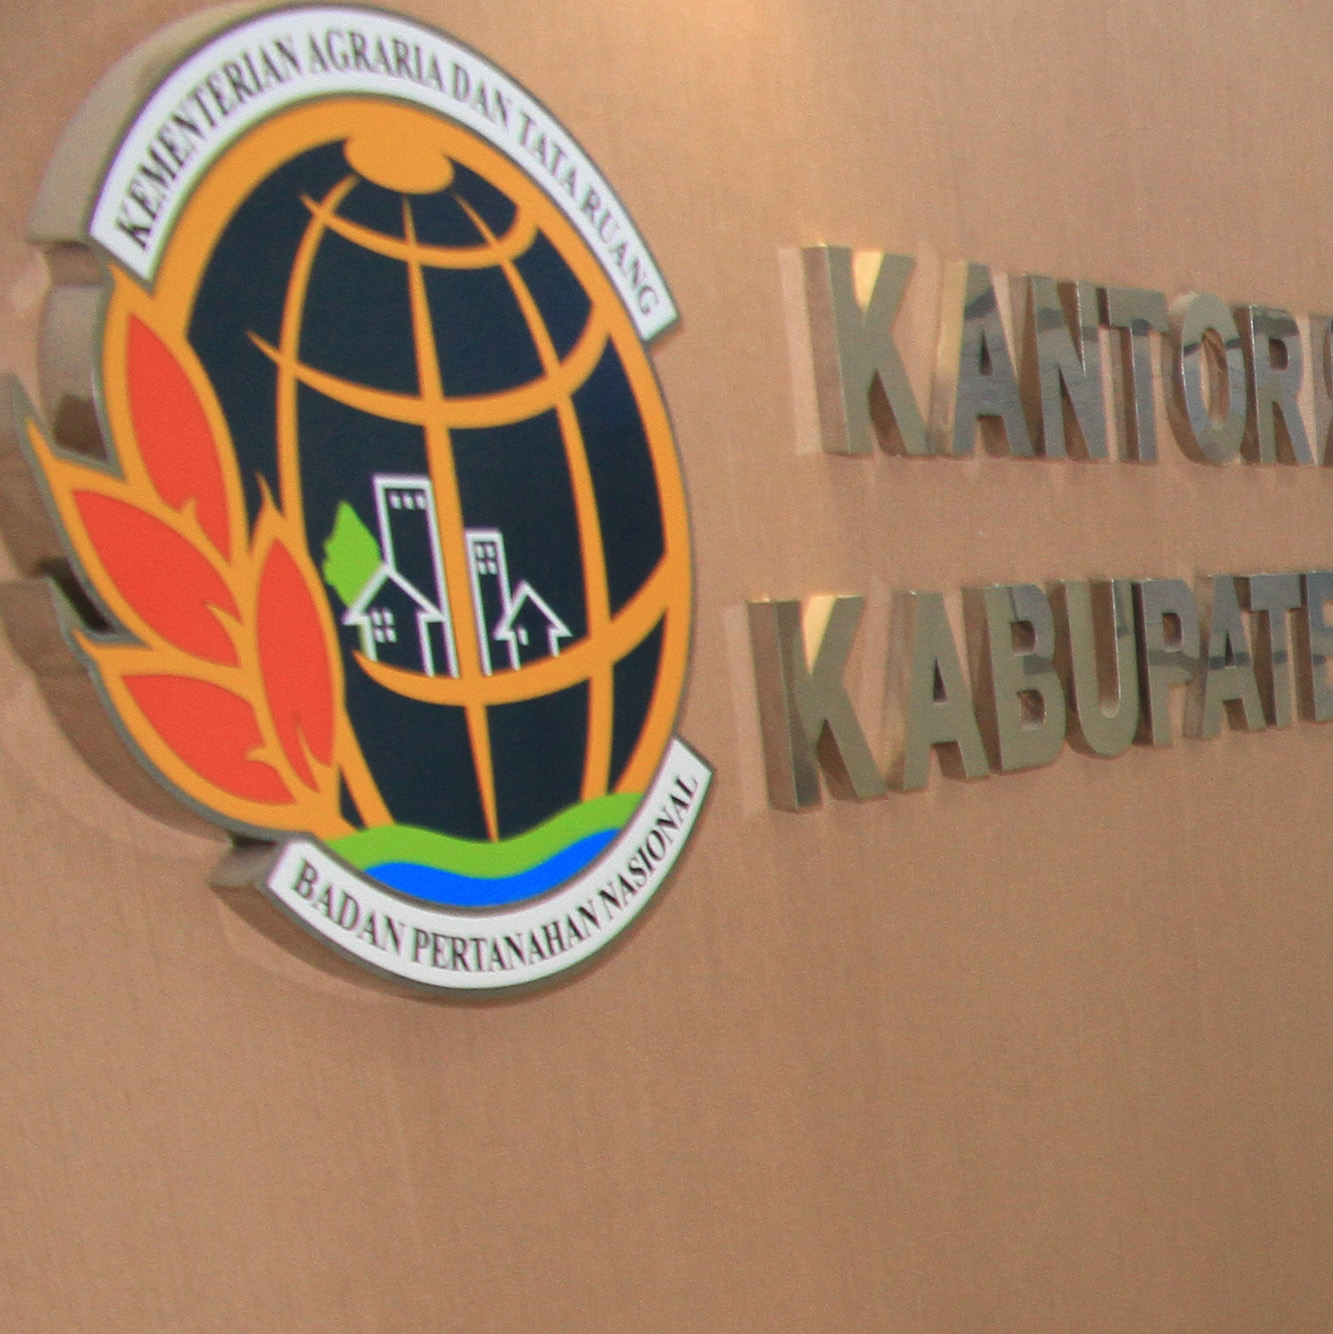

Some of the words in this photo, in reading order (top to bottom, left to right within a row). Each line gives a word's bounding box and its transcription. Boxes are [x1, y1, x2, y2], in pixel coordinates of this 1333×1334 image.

[115, 35, 303, 252] KEMENTERIAN
[307, 29, 445, 92] AGRARIA
[451, 53, 518, 129] DAN
[513, 110, 582, 197] TATA
[579, 181, 661, 318] RUANG
[803, 245, 1315, 465] KANTOR
[293, 859, 407, 960] BADAN
[413, 899, 603, 975] PERTANAHAN
[598, 772, 699, 923] NASIONAL
